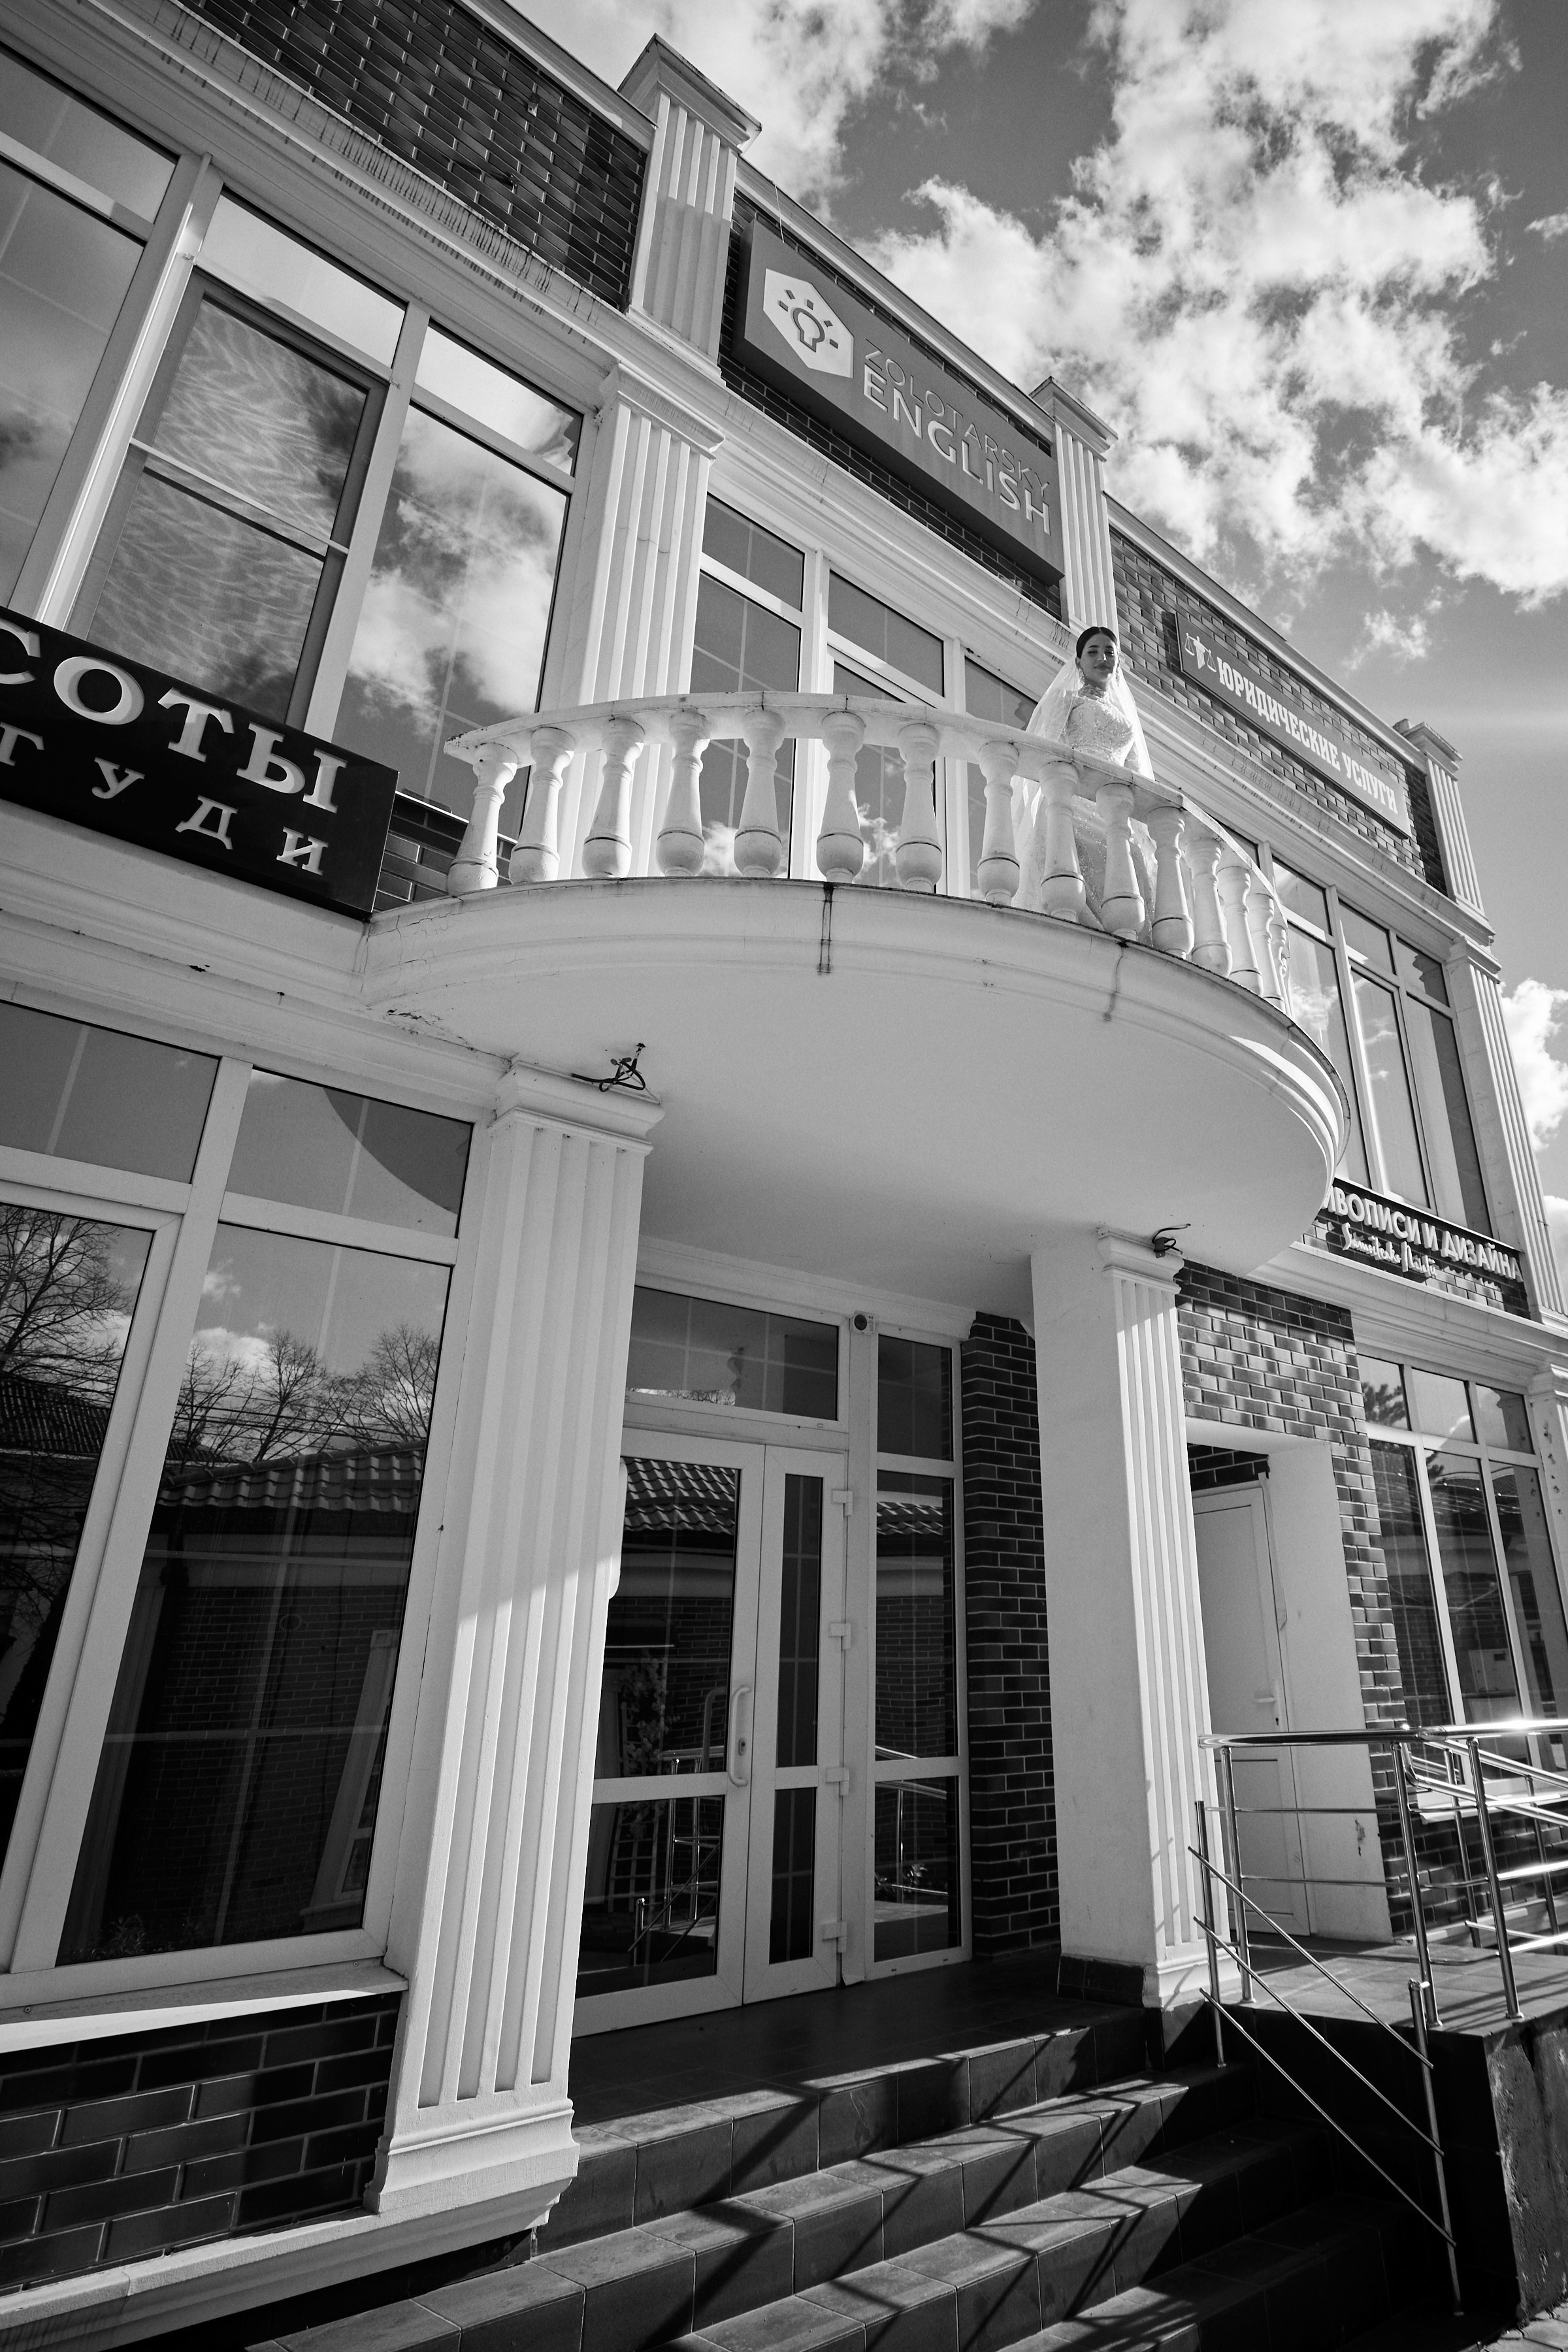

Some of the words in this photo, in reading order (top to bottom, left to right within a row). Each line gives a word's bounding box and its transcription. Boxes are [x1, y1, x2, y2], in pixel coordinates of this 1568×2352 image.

[863, 363, 1051, 536] ENGLISH
[864, 338, 1050, 497] ZOLOTARSKY
[1217, 657, 1341, 771] ЮРИДИЧЕСКИЕ
[1341, 751, 1398, 815] УСЛУГИ
[1421, 1222, 1439, 1252] И
[1440, 1230, 1524, 1282] ДИЗАЙНА
